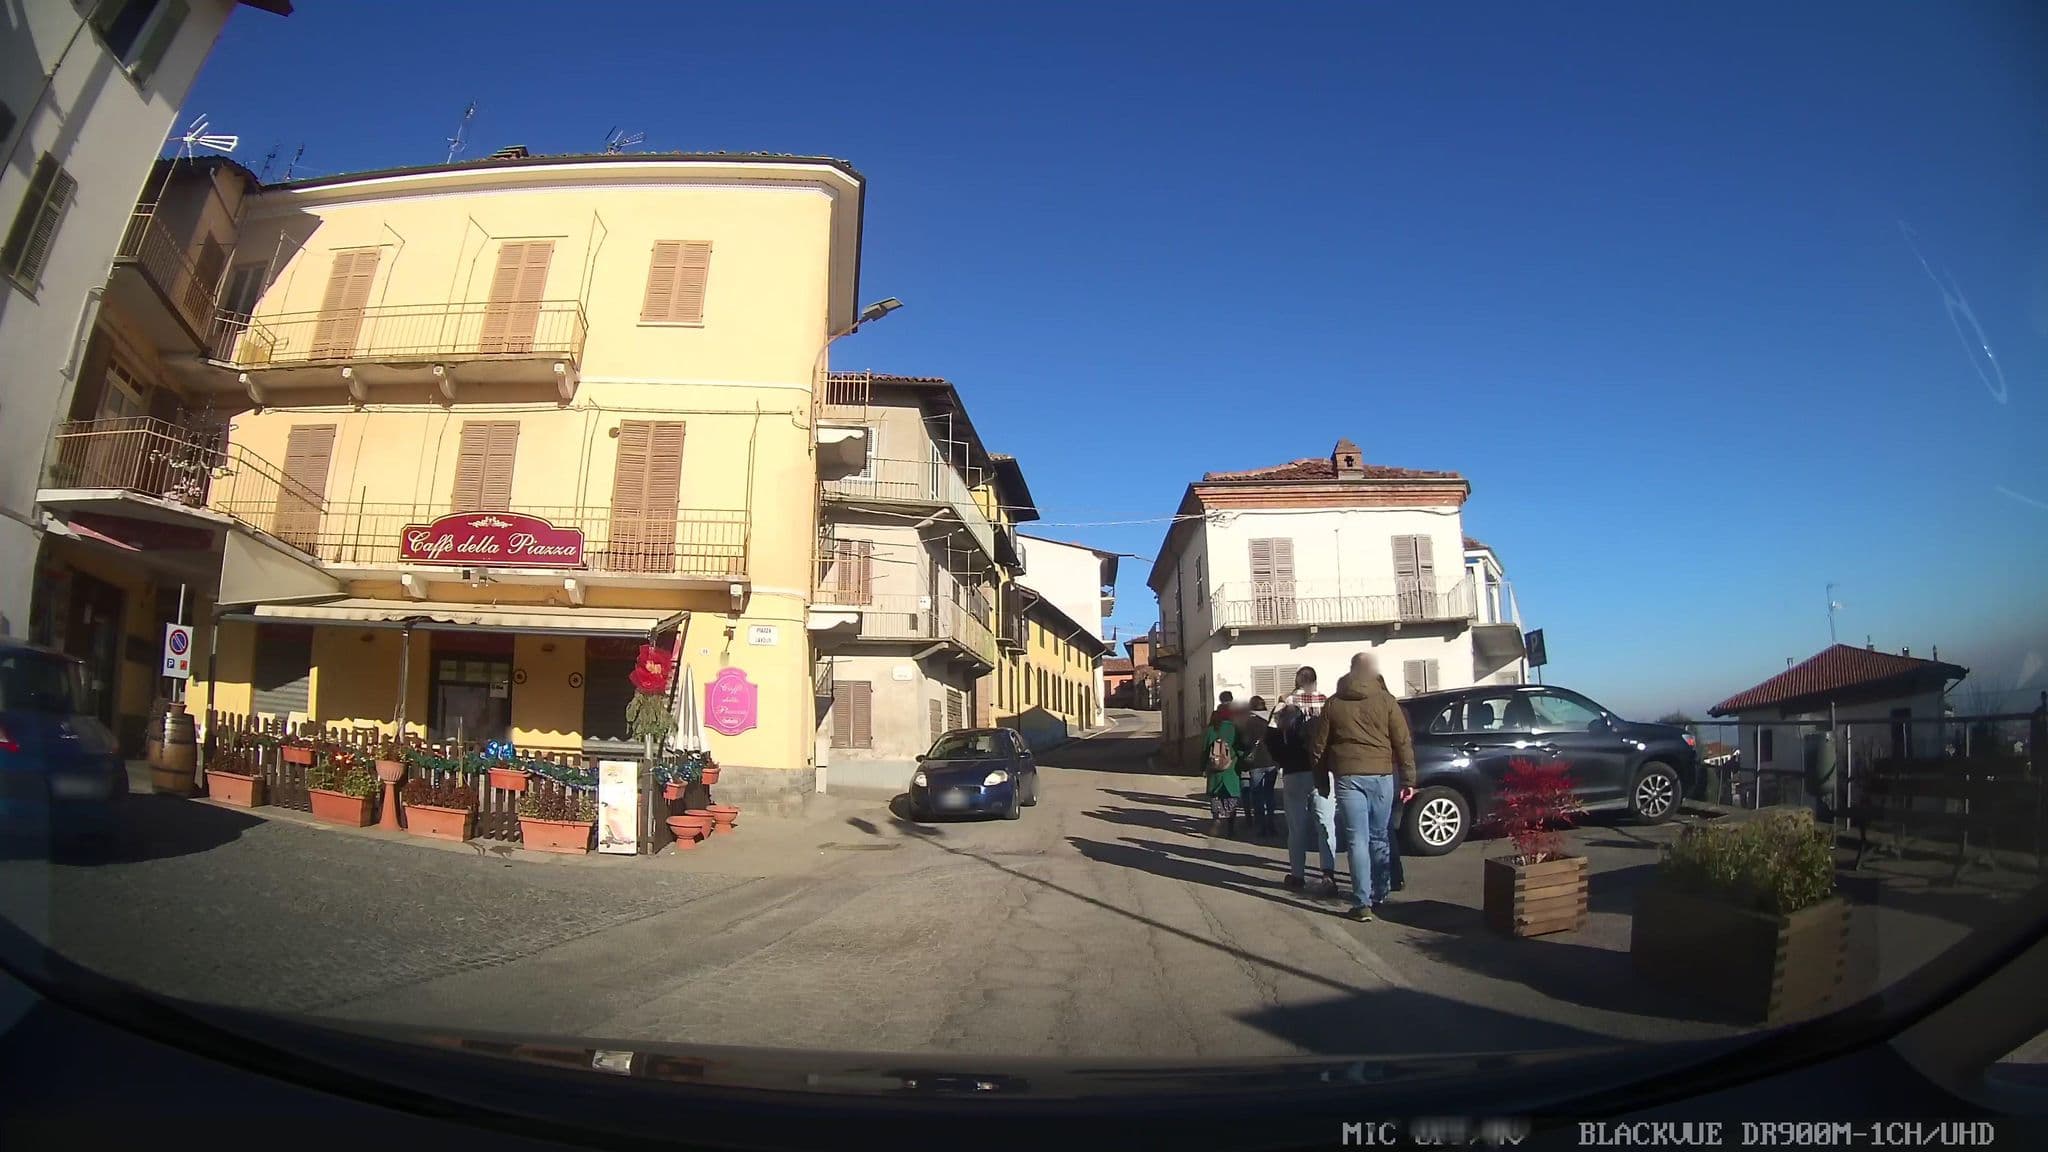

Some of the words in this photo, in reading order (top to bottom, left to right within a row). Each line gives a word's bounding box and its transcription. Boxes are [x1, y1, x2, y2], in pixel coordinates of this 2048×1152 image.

[408, 530, 453, 559] Caffè
[457, 535, 500, 554] della
[507, 532, 577, 556] Piazza
